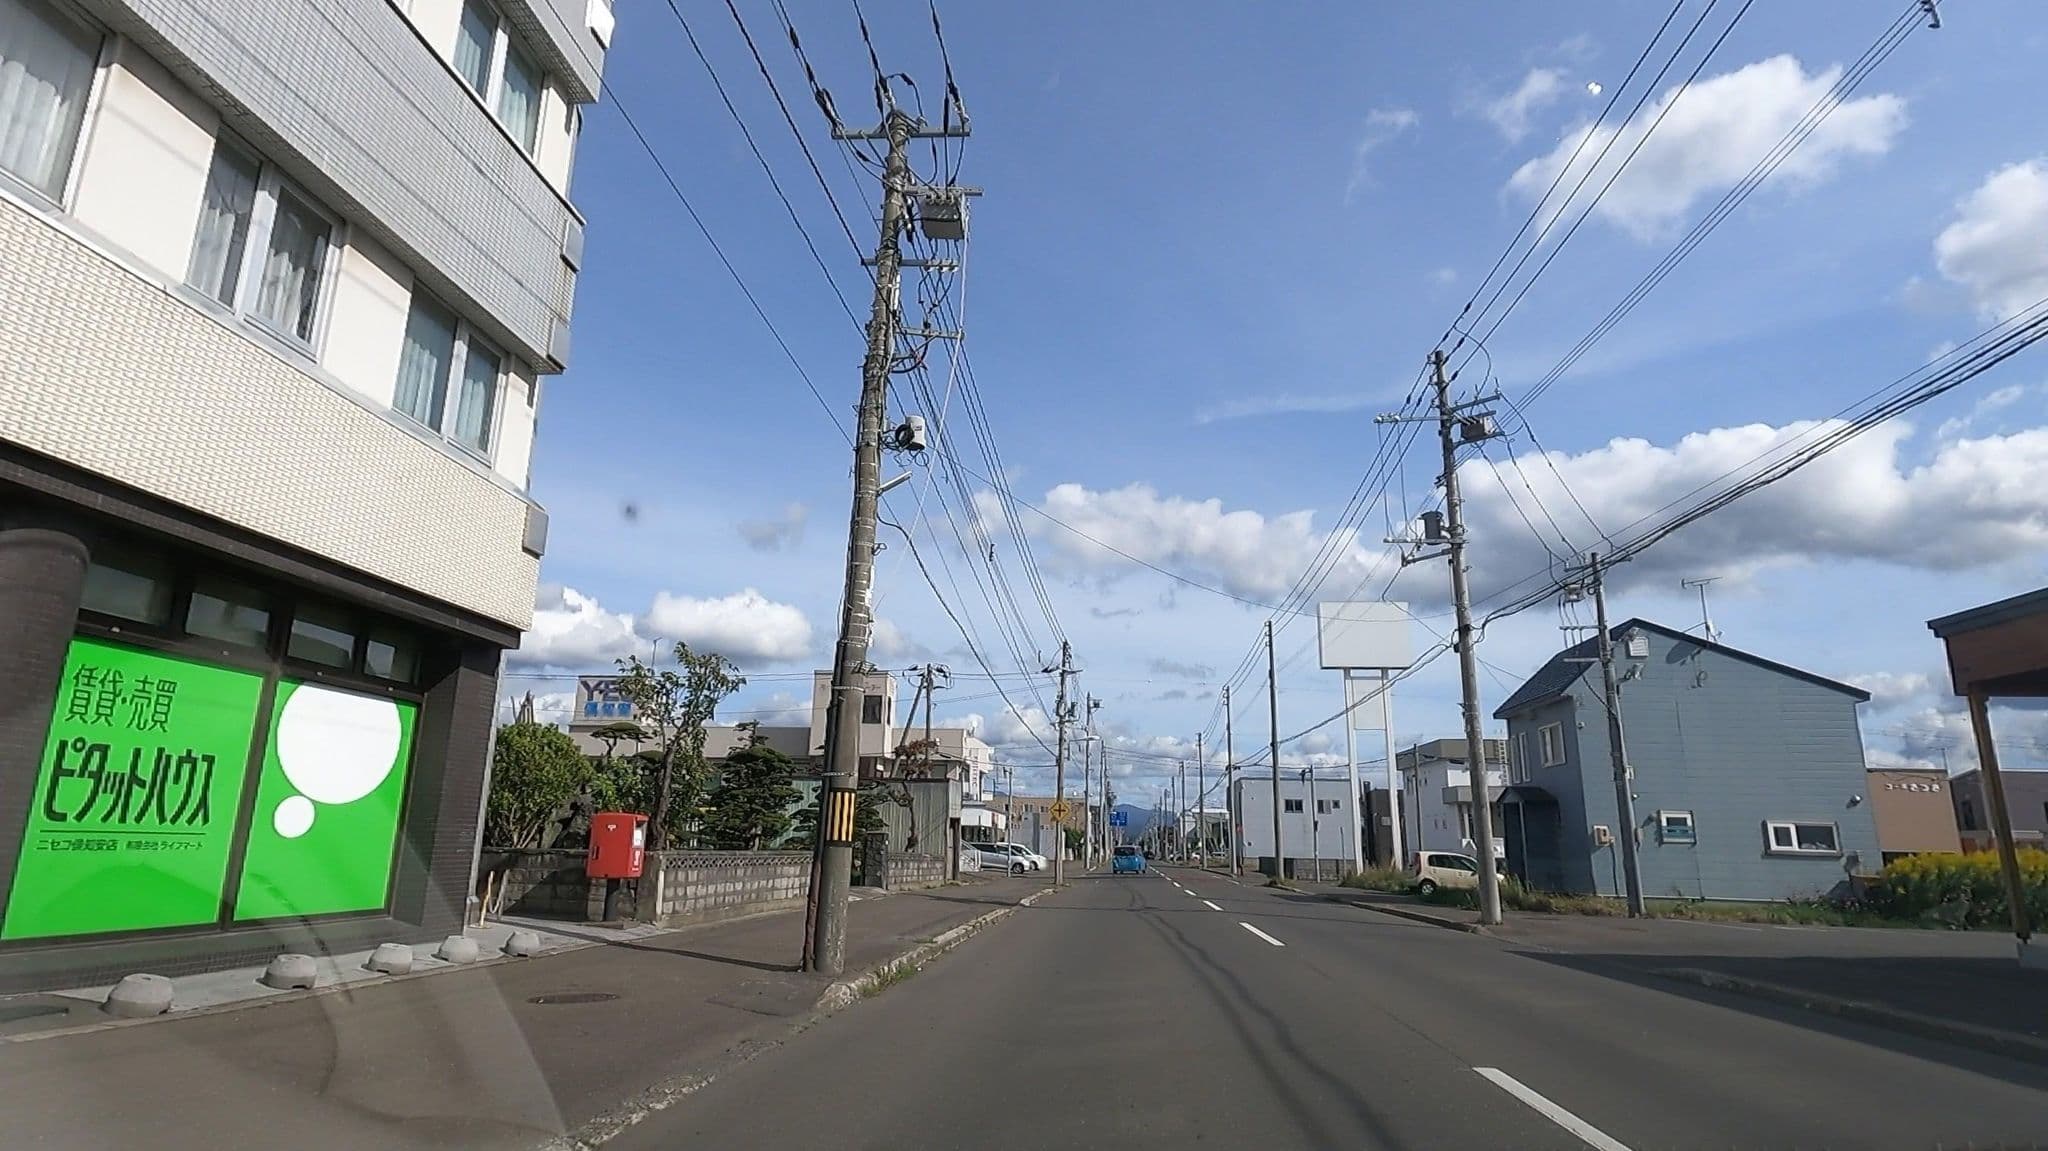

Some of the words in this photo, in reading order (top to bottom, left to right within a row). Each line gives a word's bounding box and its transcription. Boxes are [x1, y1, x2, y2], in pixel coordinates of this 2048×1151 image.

[64, 663, 178, 733] 賃貸・売買
[44, 736, 217, 827] ピタットハウス
